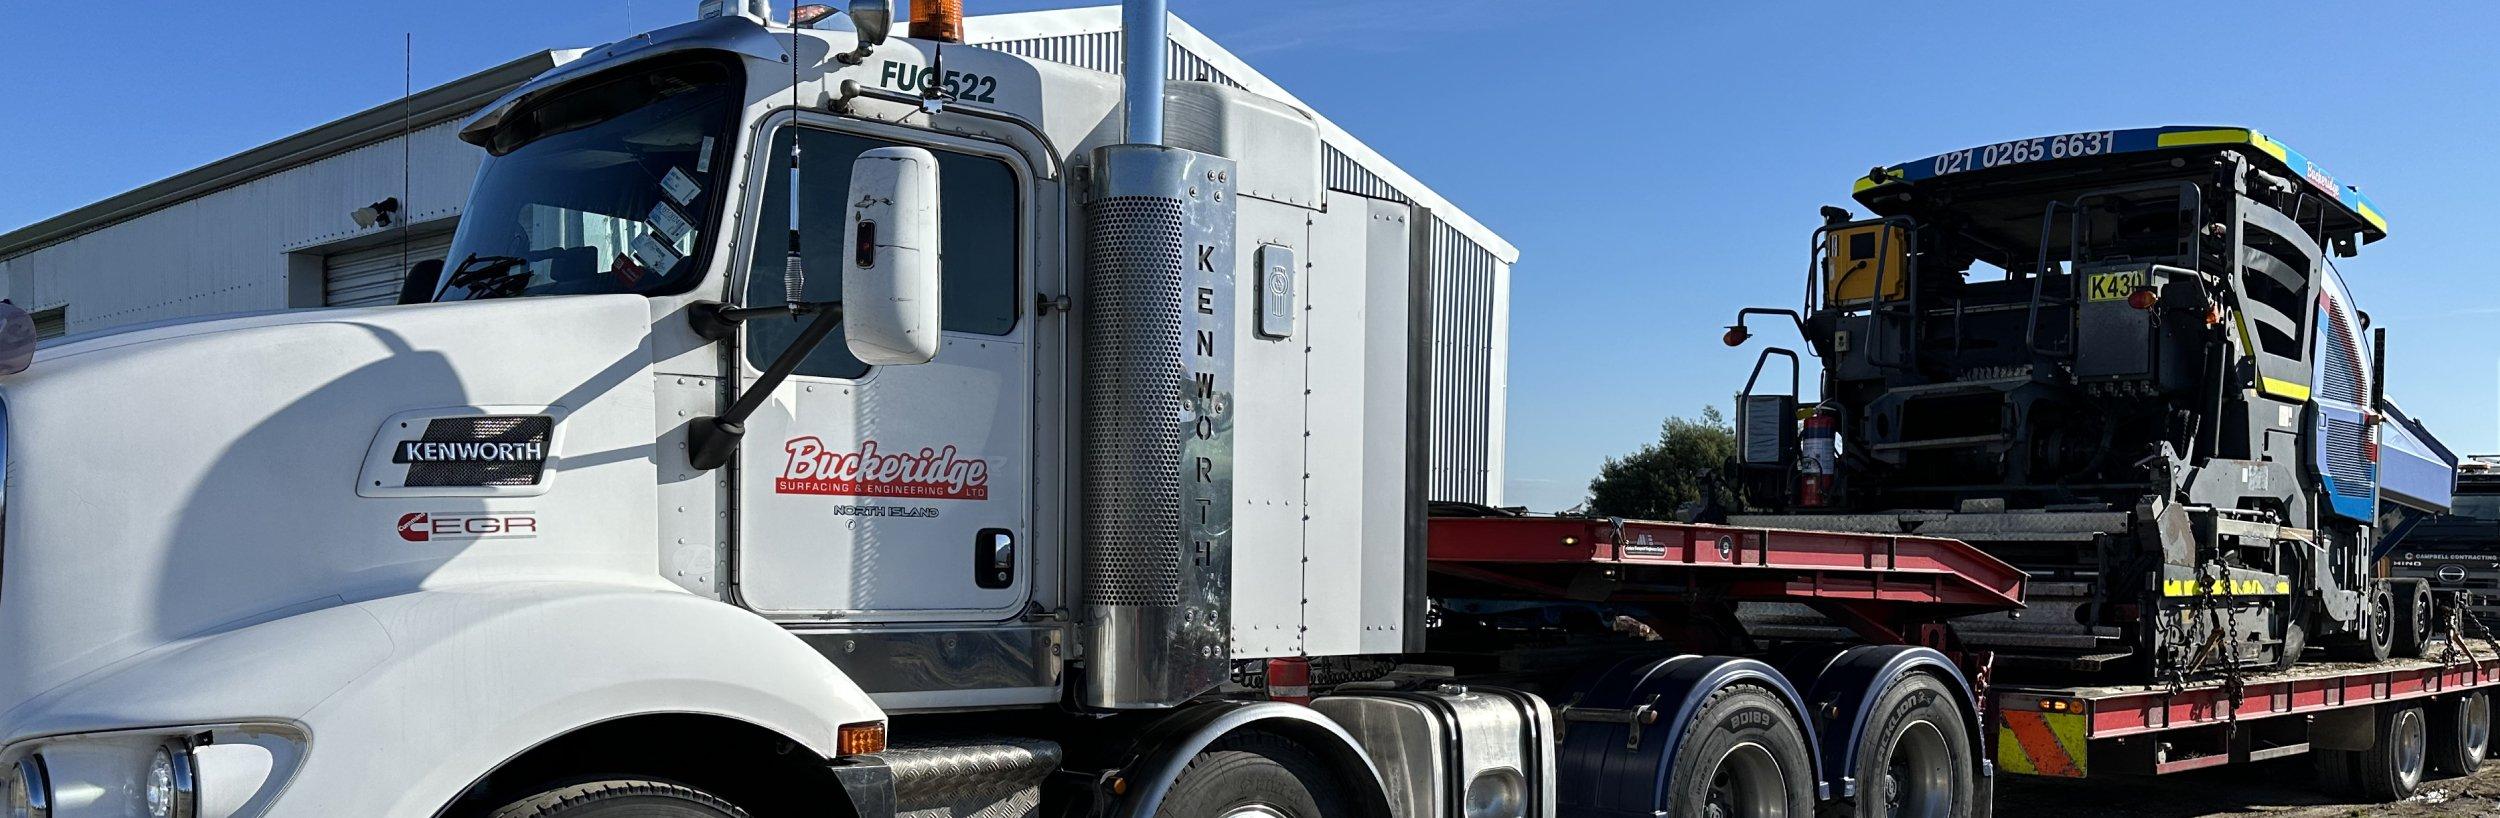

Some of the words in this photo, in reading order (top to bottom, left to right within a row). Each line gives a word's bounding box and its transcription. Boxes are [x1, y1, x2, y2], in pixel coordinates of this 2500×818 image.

[880, 60, 997, 104] FUG522
[1934, 148, 1974, 177] 021
[1982, 137, 2046, 169] 0265
[2051, 130, 2115, 160] 6631
[1195, 244, 1215, 567] KENWORTH
[406, 442, 542, 461] KENWORTH
[785, 435, 988, 495] Buckeridge
[779, 481, 850, 493] SURFACING
[854, 484, 862, 493] &
[867, 484, 944, 496] ENGINEERING
[966, 488, 985, 497] LTD
[431, 517, 537, 535] EGR
[833, 505, 886, 517] NORTH
[887, 506, 940, 518] ISLAND
